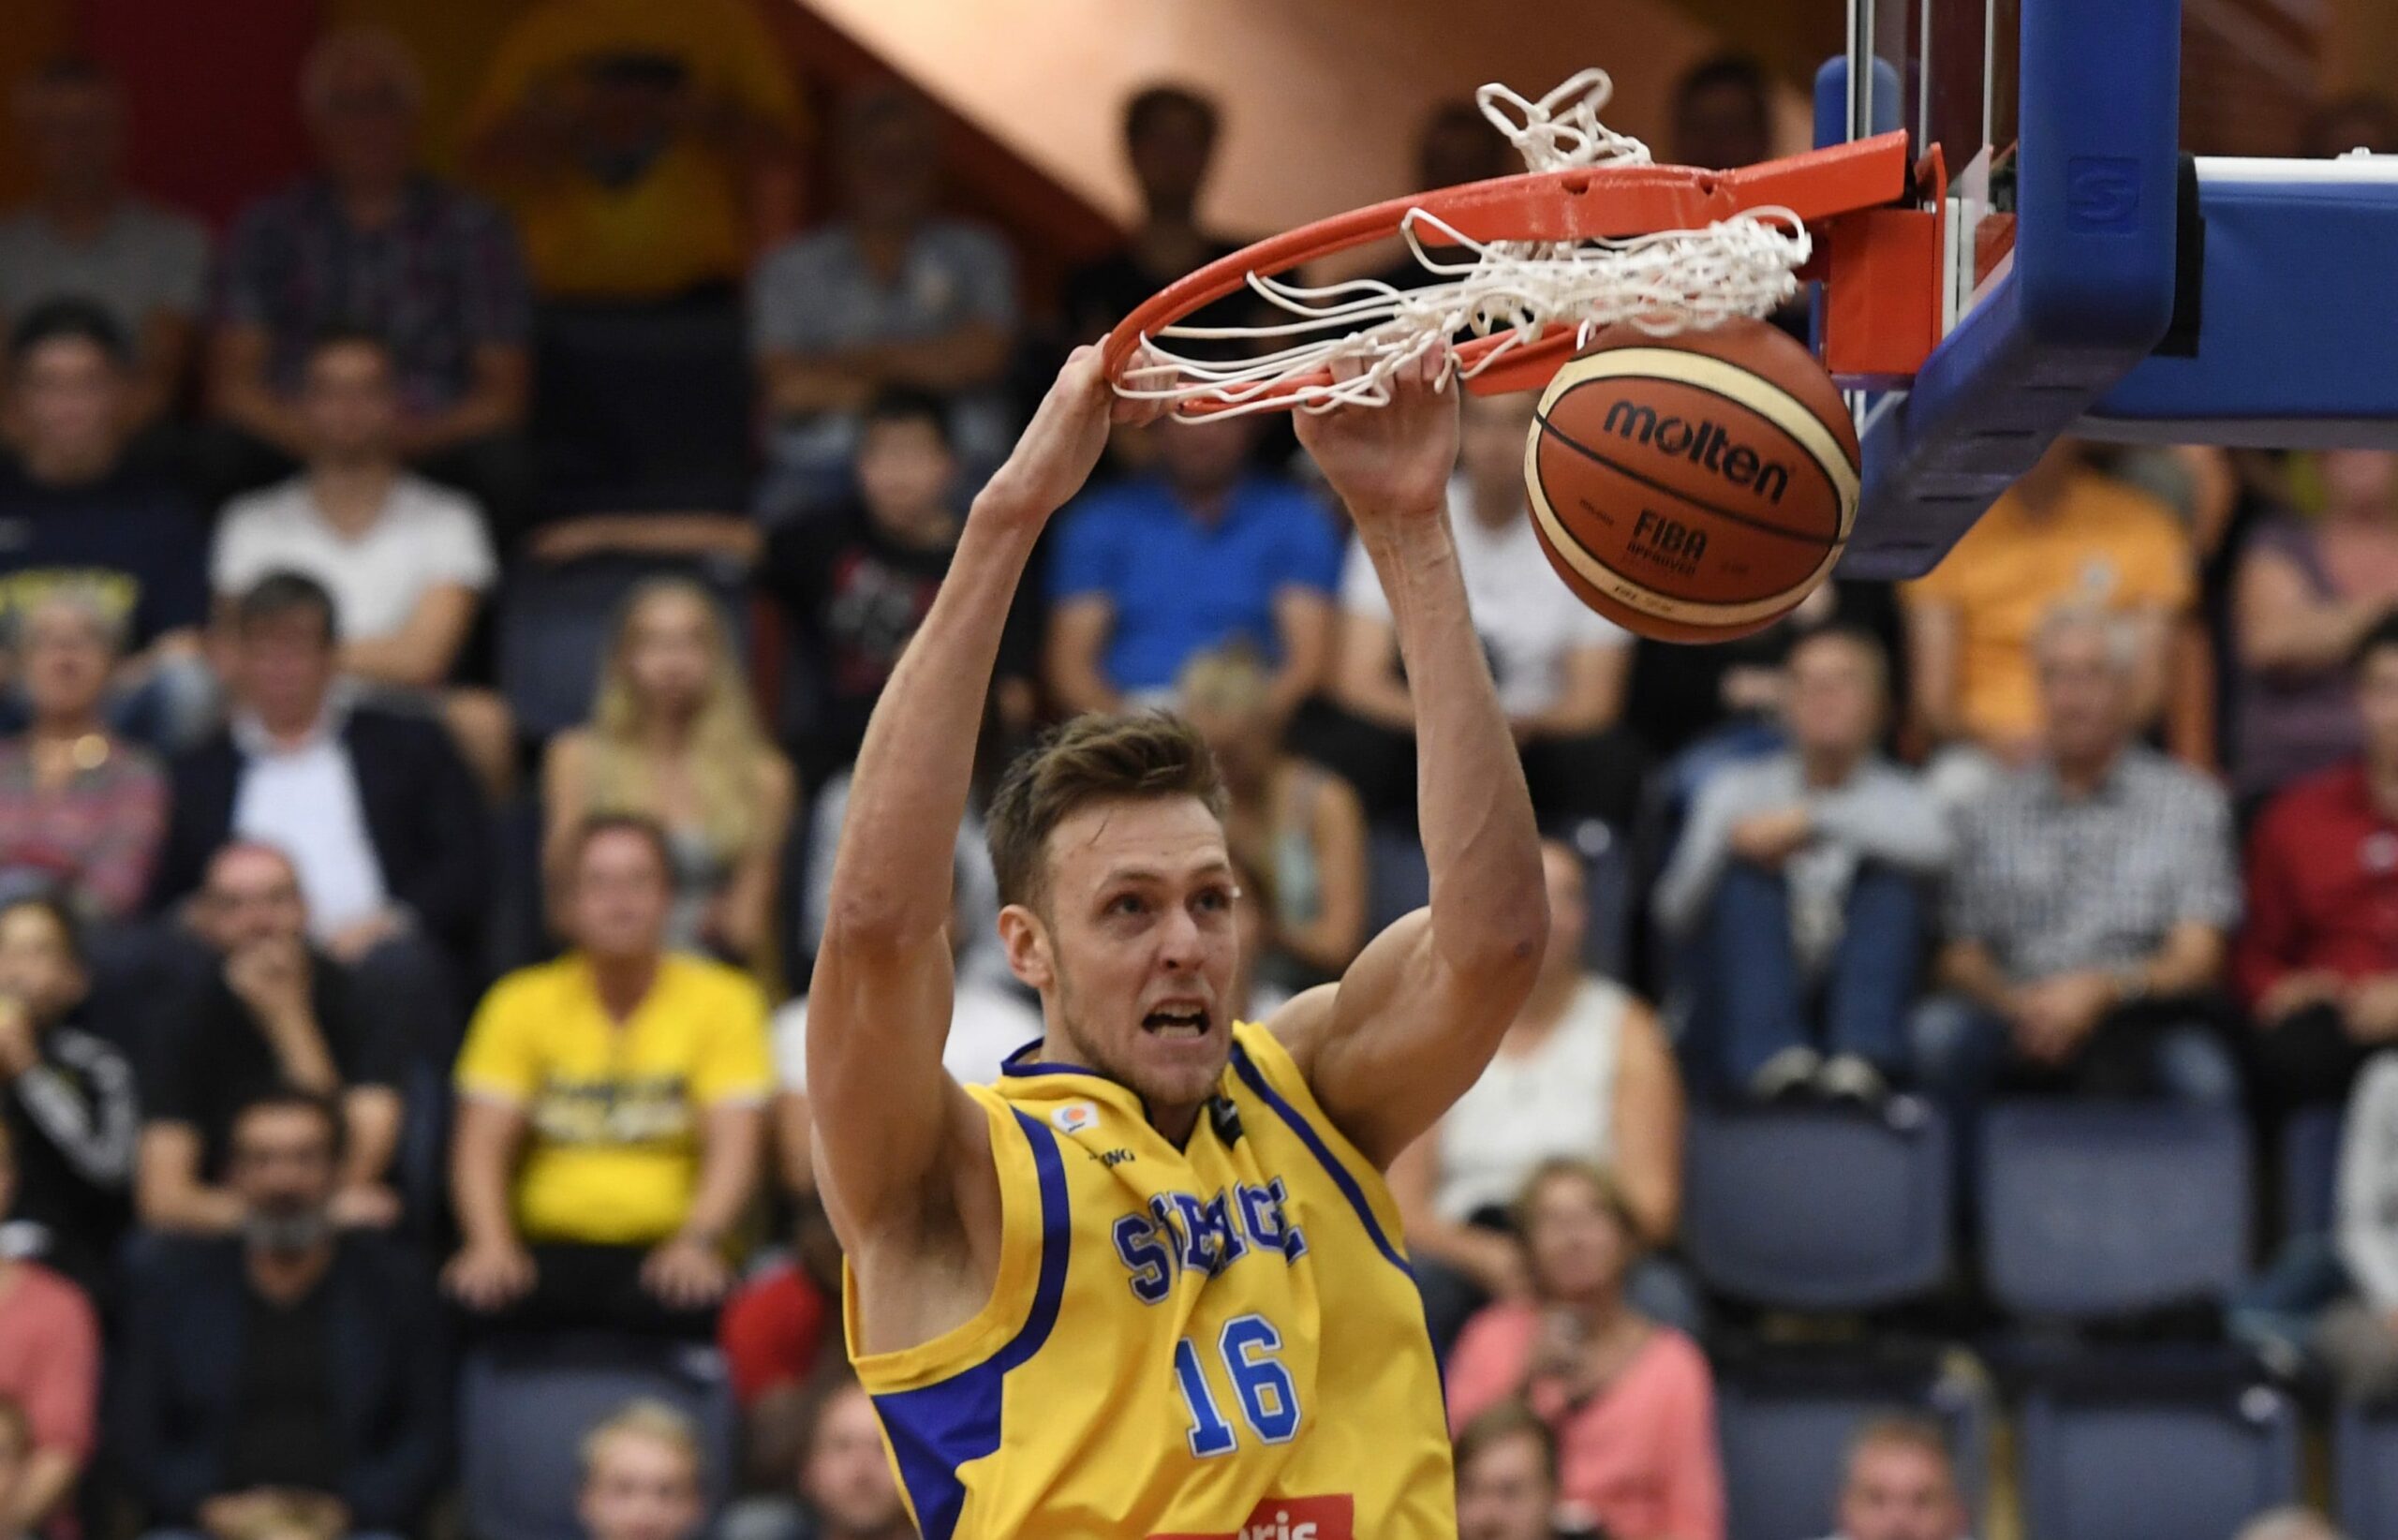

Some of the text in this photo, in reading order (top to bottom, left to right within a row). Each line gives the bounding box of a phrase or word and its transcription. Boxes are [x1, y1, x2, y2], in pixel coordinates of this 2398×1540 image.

[1603, 399, 1789, 505] molten
[1633, 509, 1708, 562] FIBA
[1174, 1313, 1302, 1459] 16
